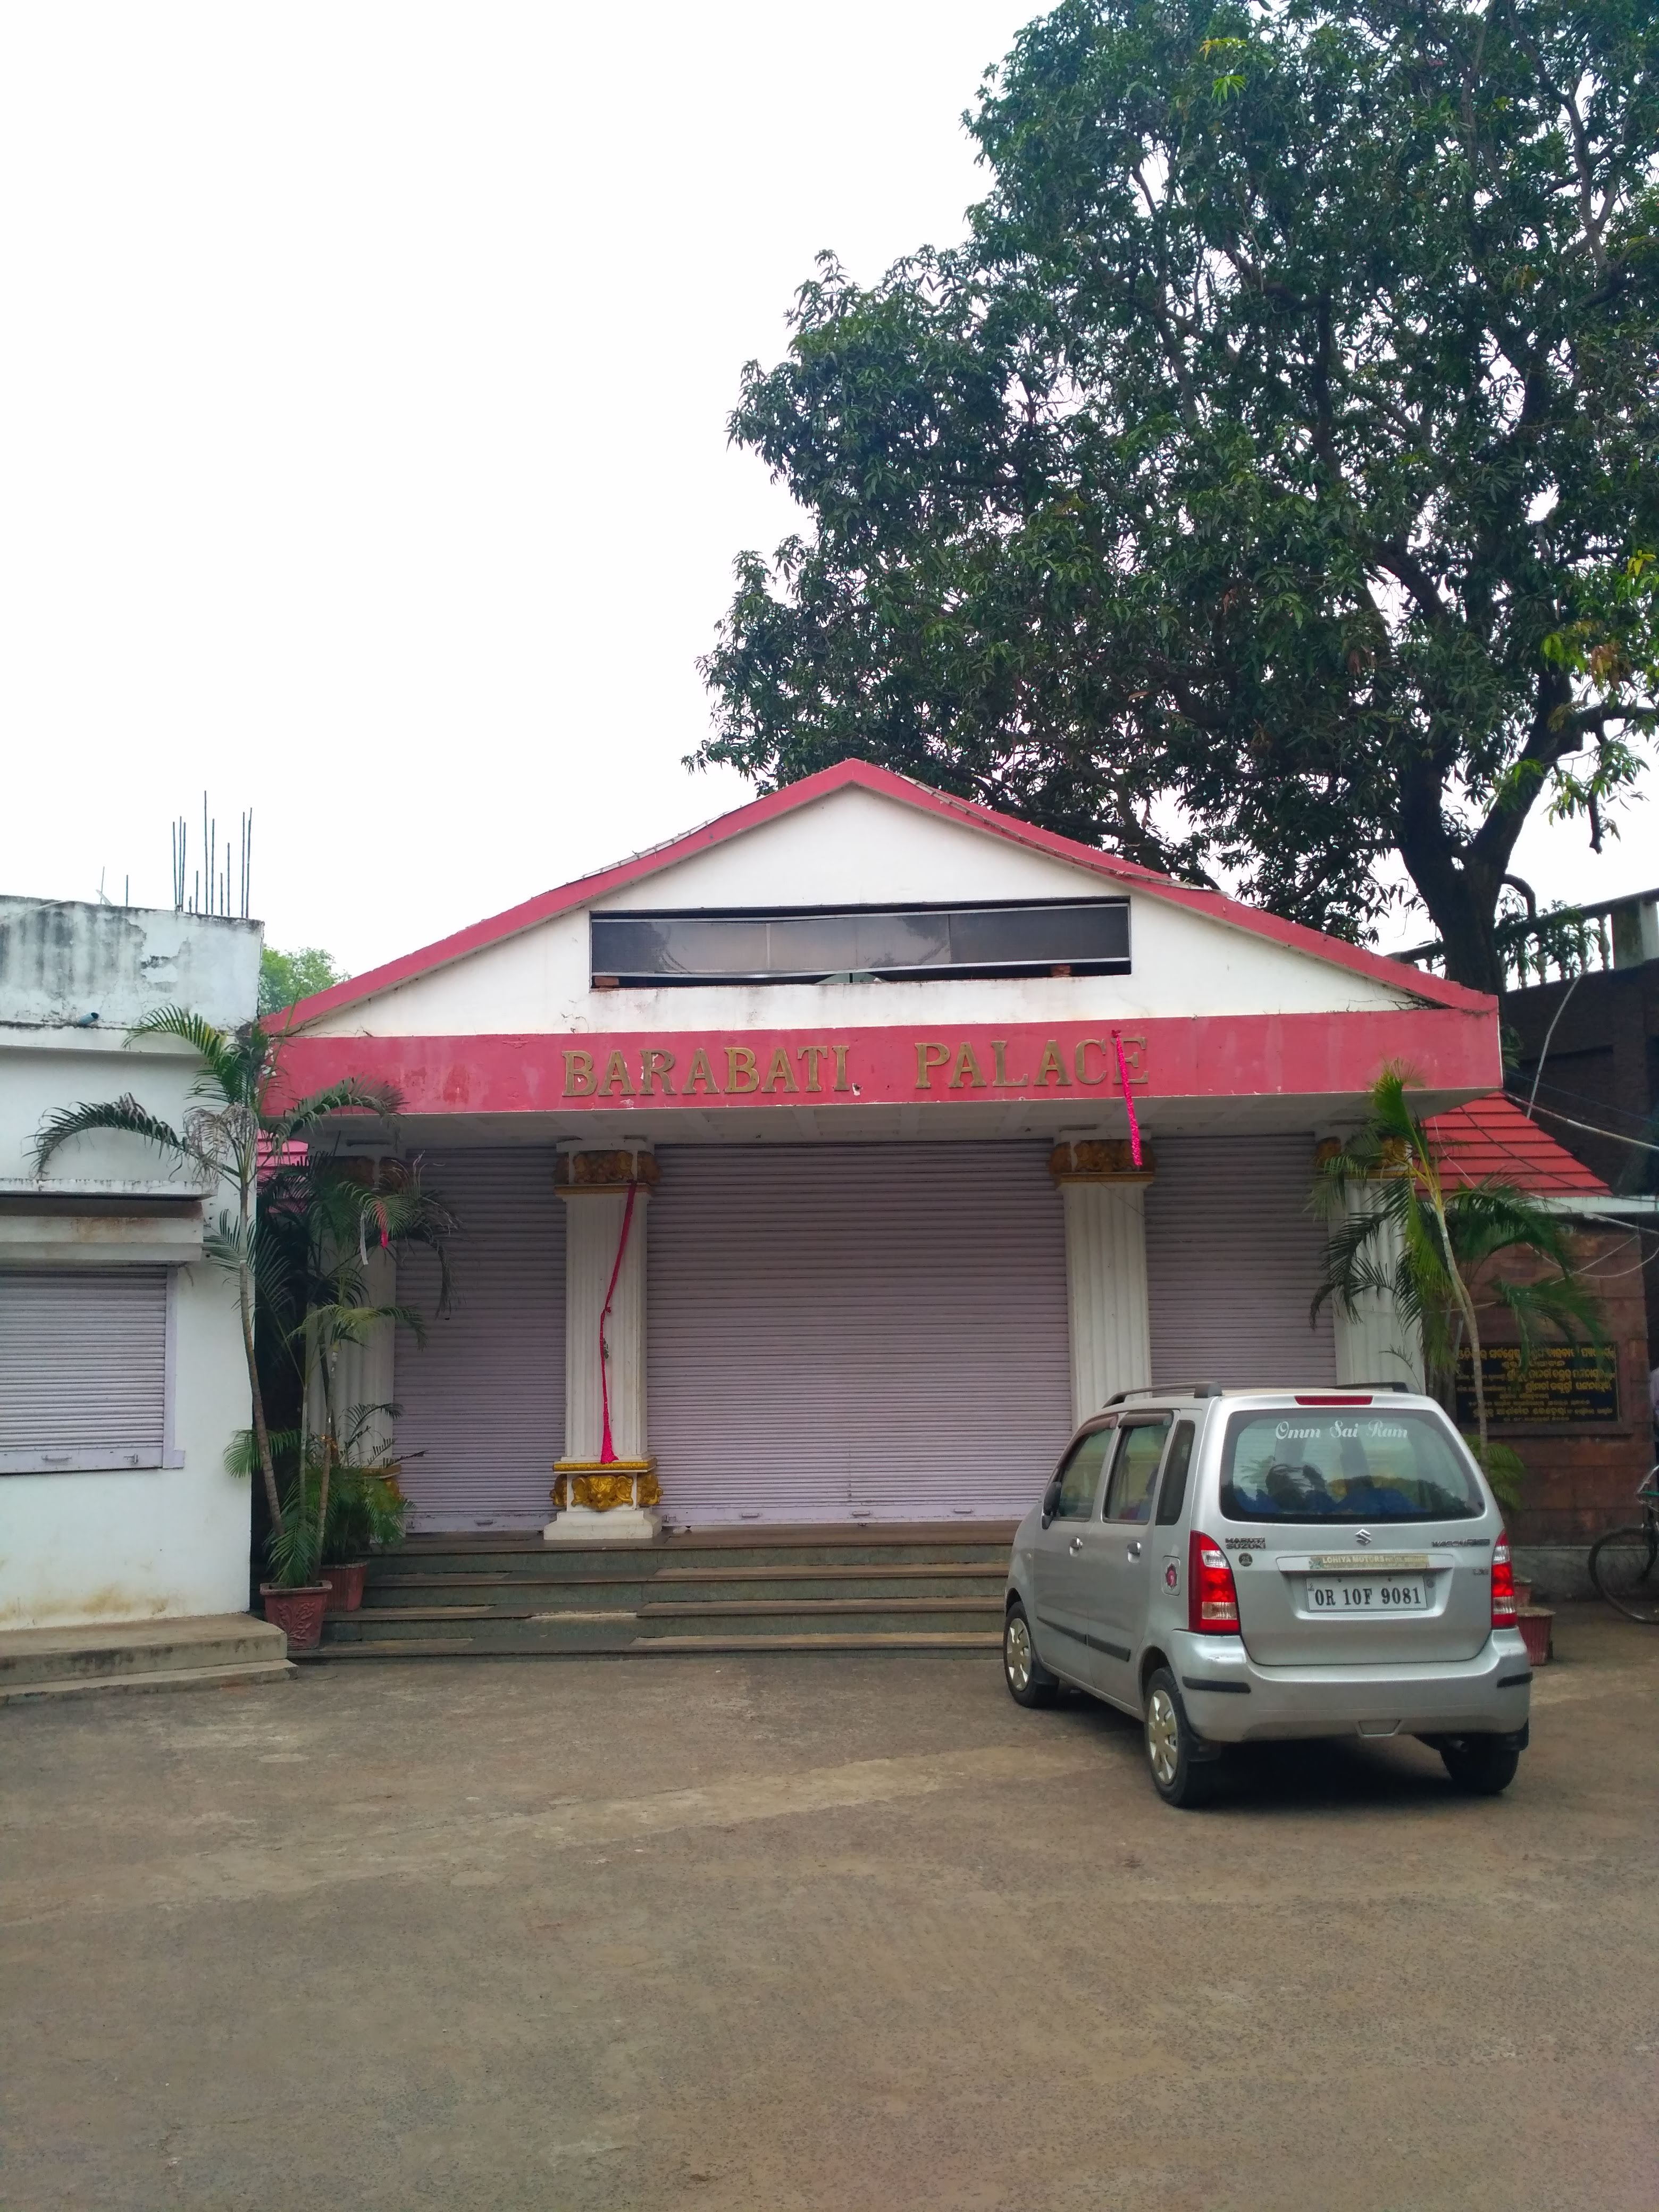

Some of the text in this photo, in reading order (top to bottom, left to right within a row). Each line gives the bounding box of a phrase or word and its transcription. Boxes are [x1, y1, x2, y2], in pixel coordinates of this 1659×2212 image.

[562, 1036, 1149, 1096] BARABATI PALACE
[1330, 1420, 1359, 1438] Sai
[1368, 1420, 1408, 1438] Ram
[1315, 1587, 1421, 1606] OR 10F 9081
